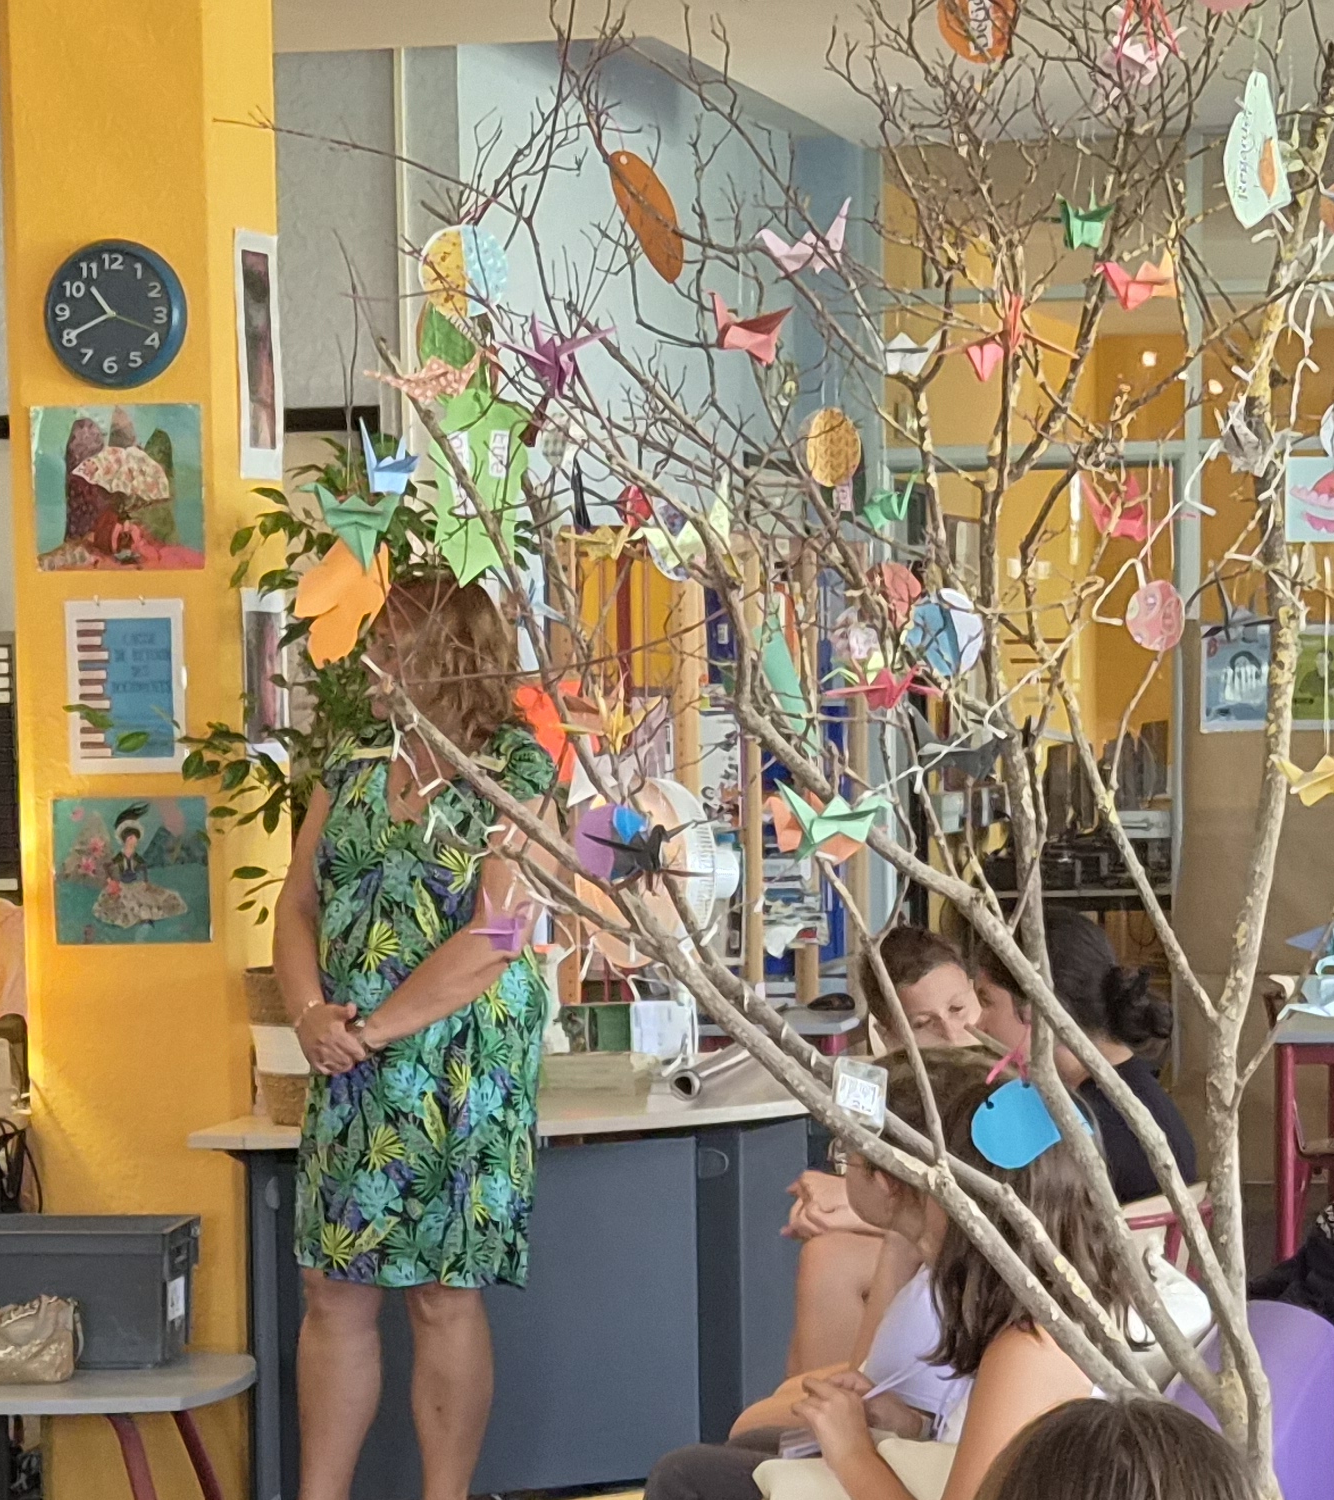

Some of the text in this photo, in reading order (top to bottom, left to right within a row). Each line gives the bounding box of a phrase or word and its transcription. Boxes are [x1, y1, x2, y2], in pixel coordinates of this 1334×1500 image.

[79, 261, 98, 279] 11
[102, 253, 124, 271] 12
[134, 262, 144, 279] 1
[62, 281, 86, 298] 10
[147, 281, 163, 298] 2
[55, 303, 71, 322] 9
[153, 305, 168, 324] 3
[62, 329, 79, 348] 8
[144, 331, 161, 350] 4
[80, 349, 94, 366] 7
[102, 356, 118, 374] 6
[127, 351, 144, 368] 5
